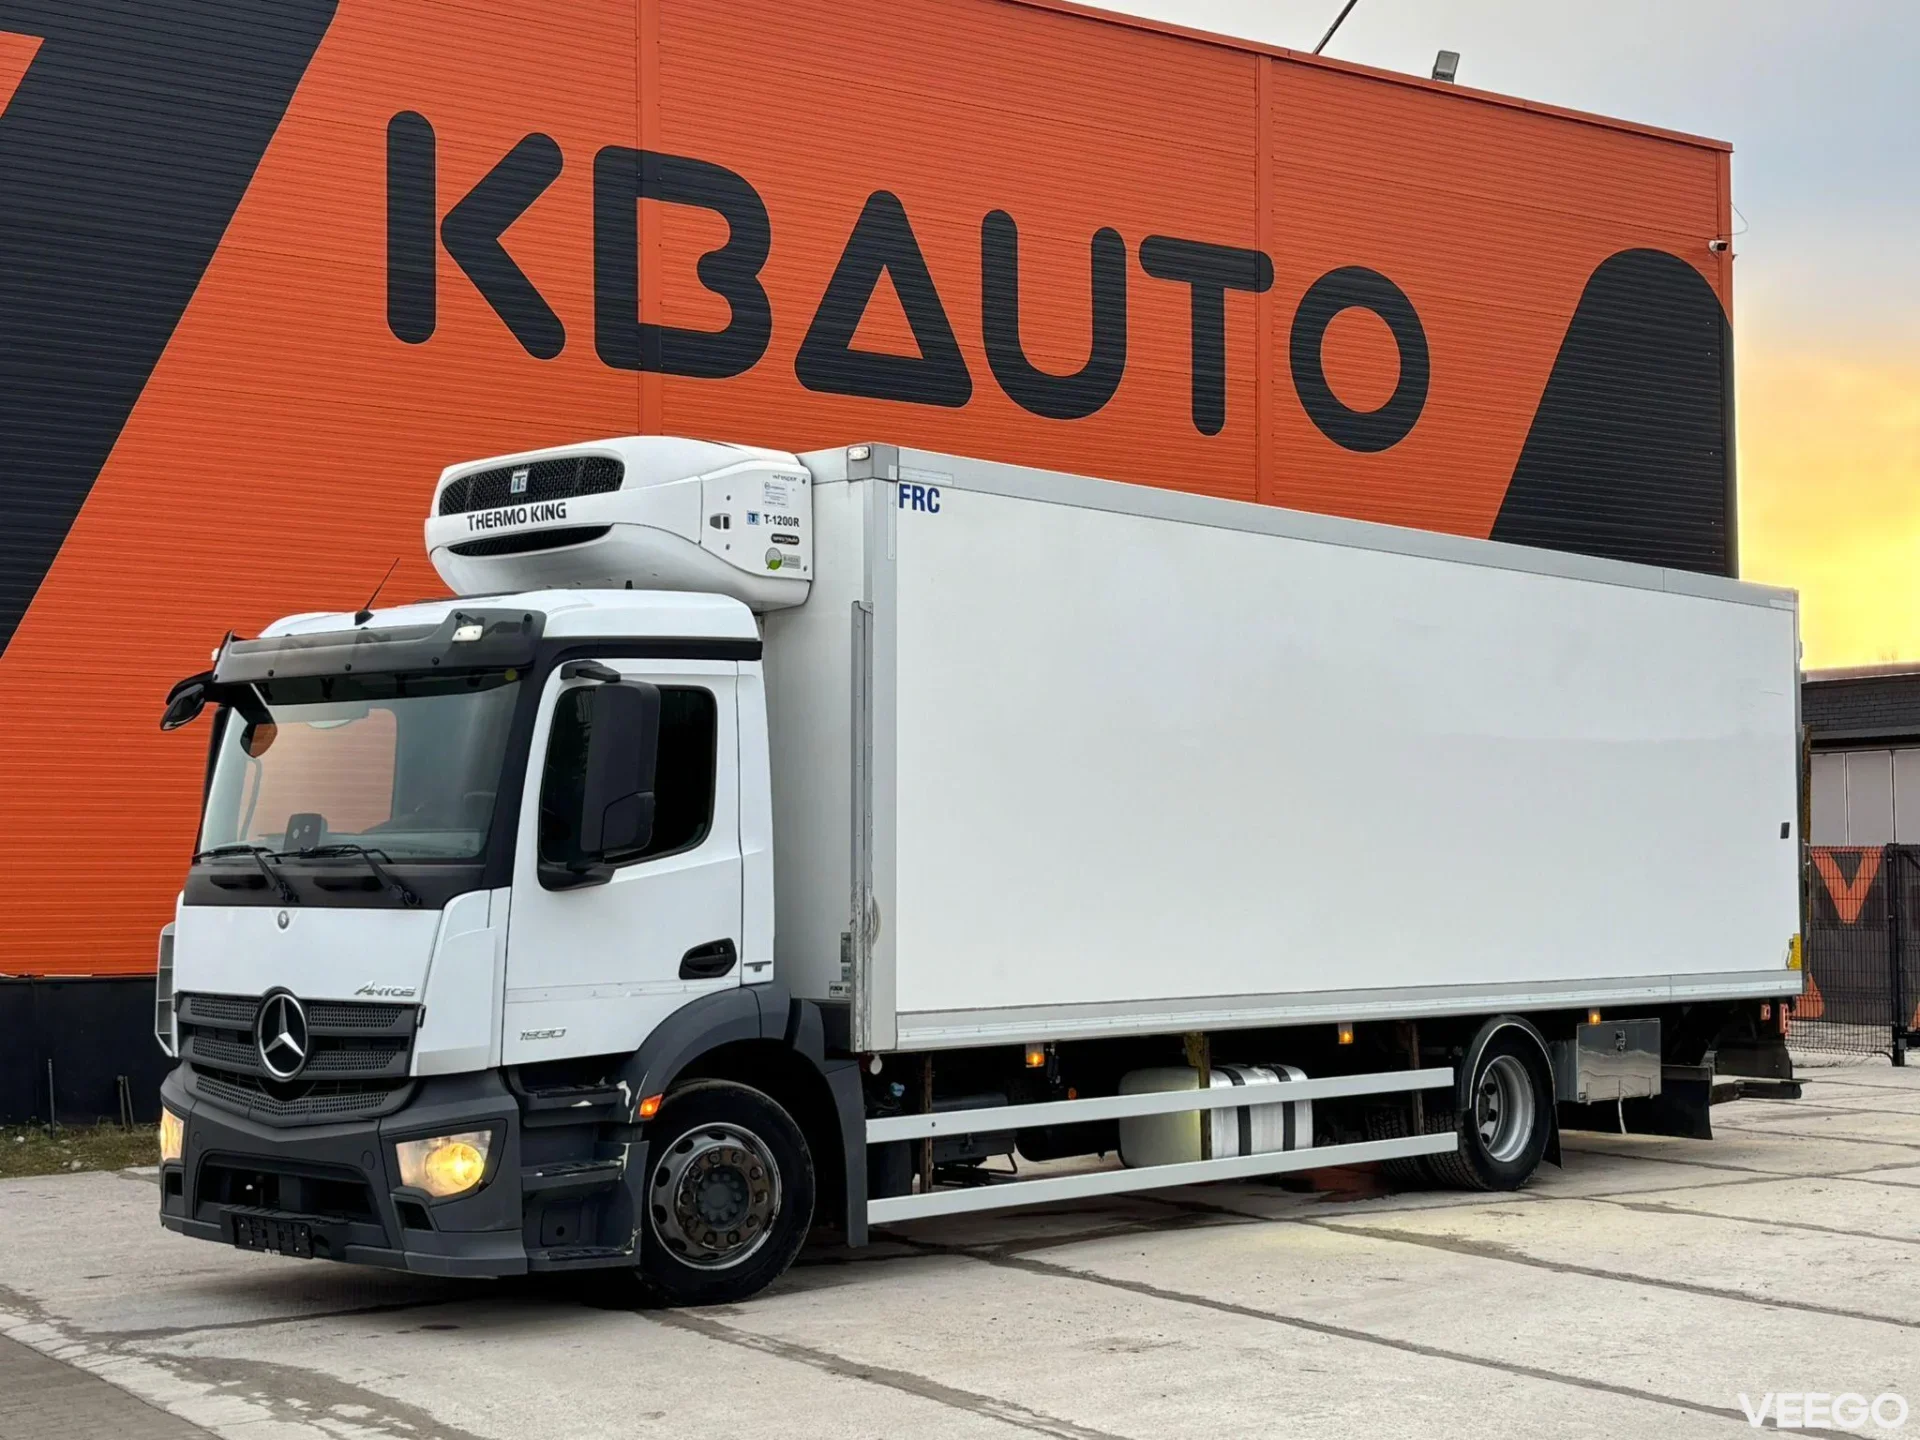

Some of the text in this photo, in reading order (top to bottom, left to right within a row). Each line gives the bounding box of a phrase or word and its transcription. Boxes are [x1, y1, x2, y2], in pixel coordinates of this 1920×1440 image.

[899, 483, 941, 514] FRC
[467, 502, 567, 531] THERMO KING
[763, 513, 800, 528] T-1200R
